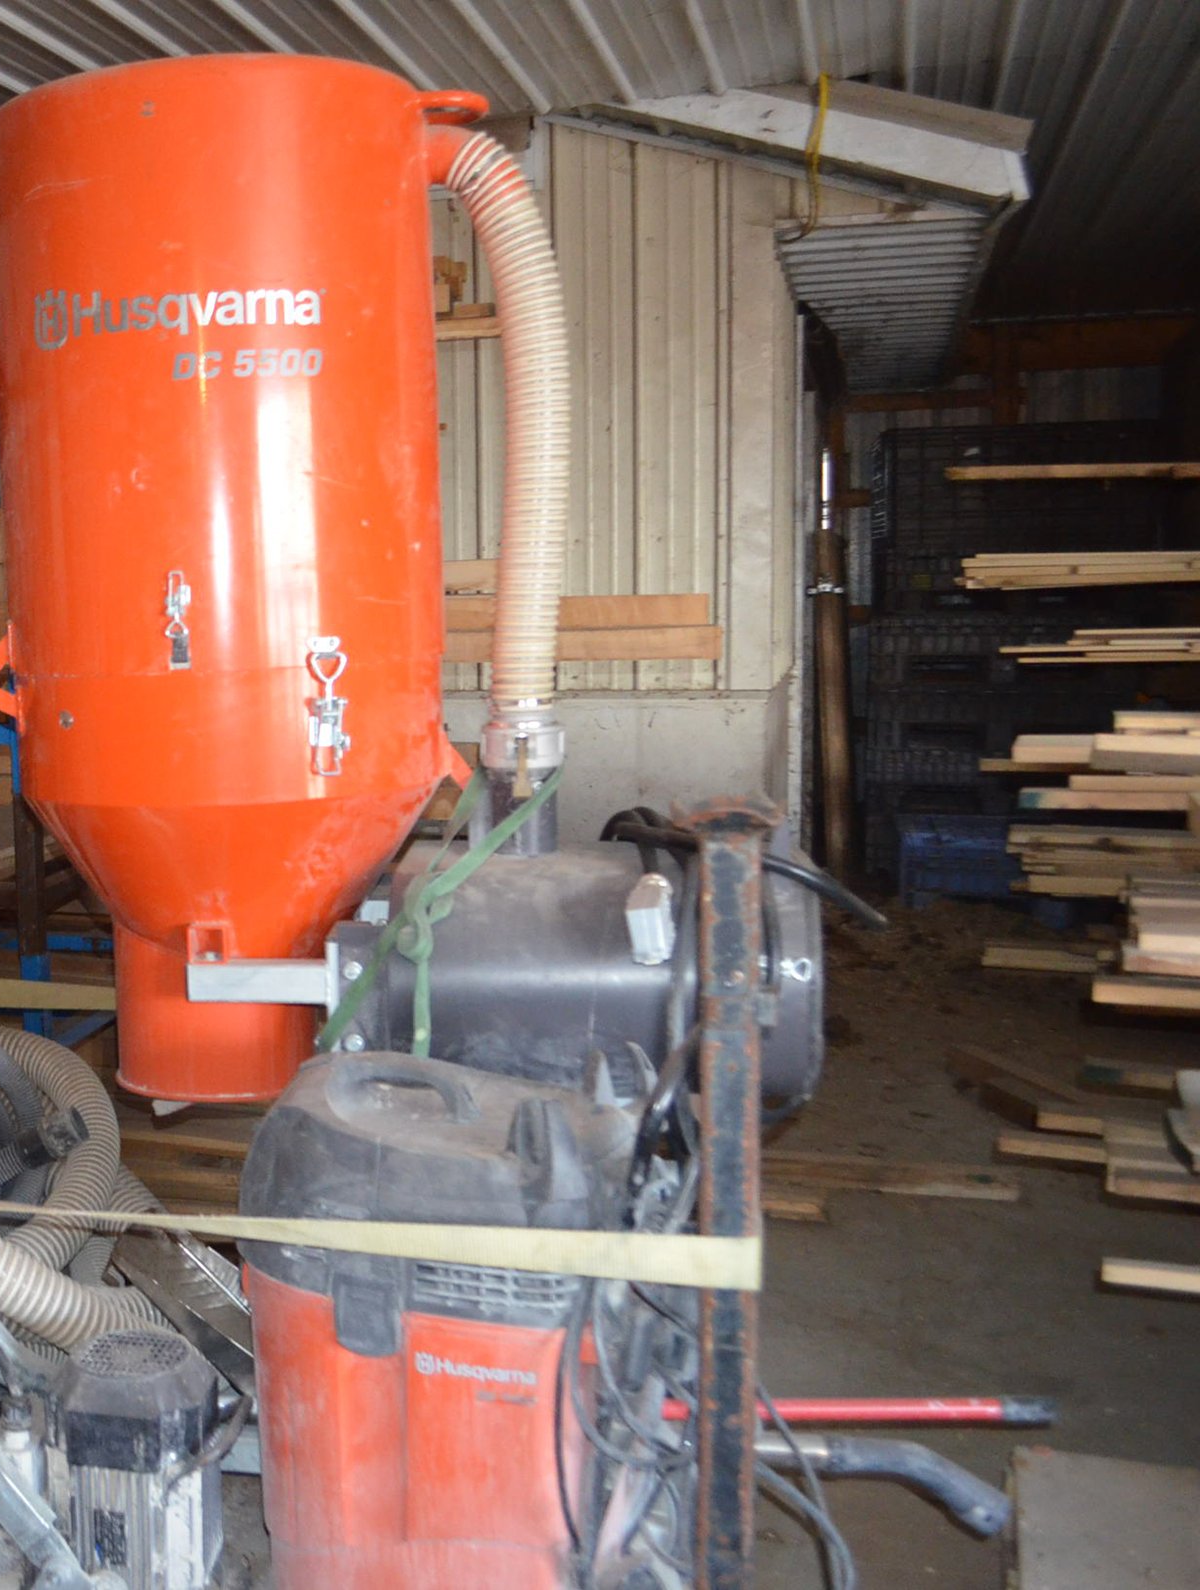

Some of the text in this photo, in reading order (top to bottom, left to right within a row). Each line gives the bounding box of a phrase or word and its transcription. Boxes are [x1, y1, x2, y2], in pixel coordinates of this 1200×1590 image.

[72, 288, 321, 336] Husqvarna
[172, 348, 322, 380] DC 5500
[437, 1358, 537, 1385] Husqvarna
